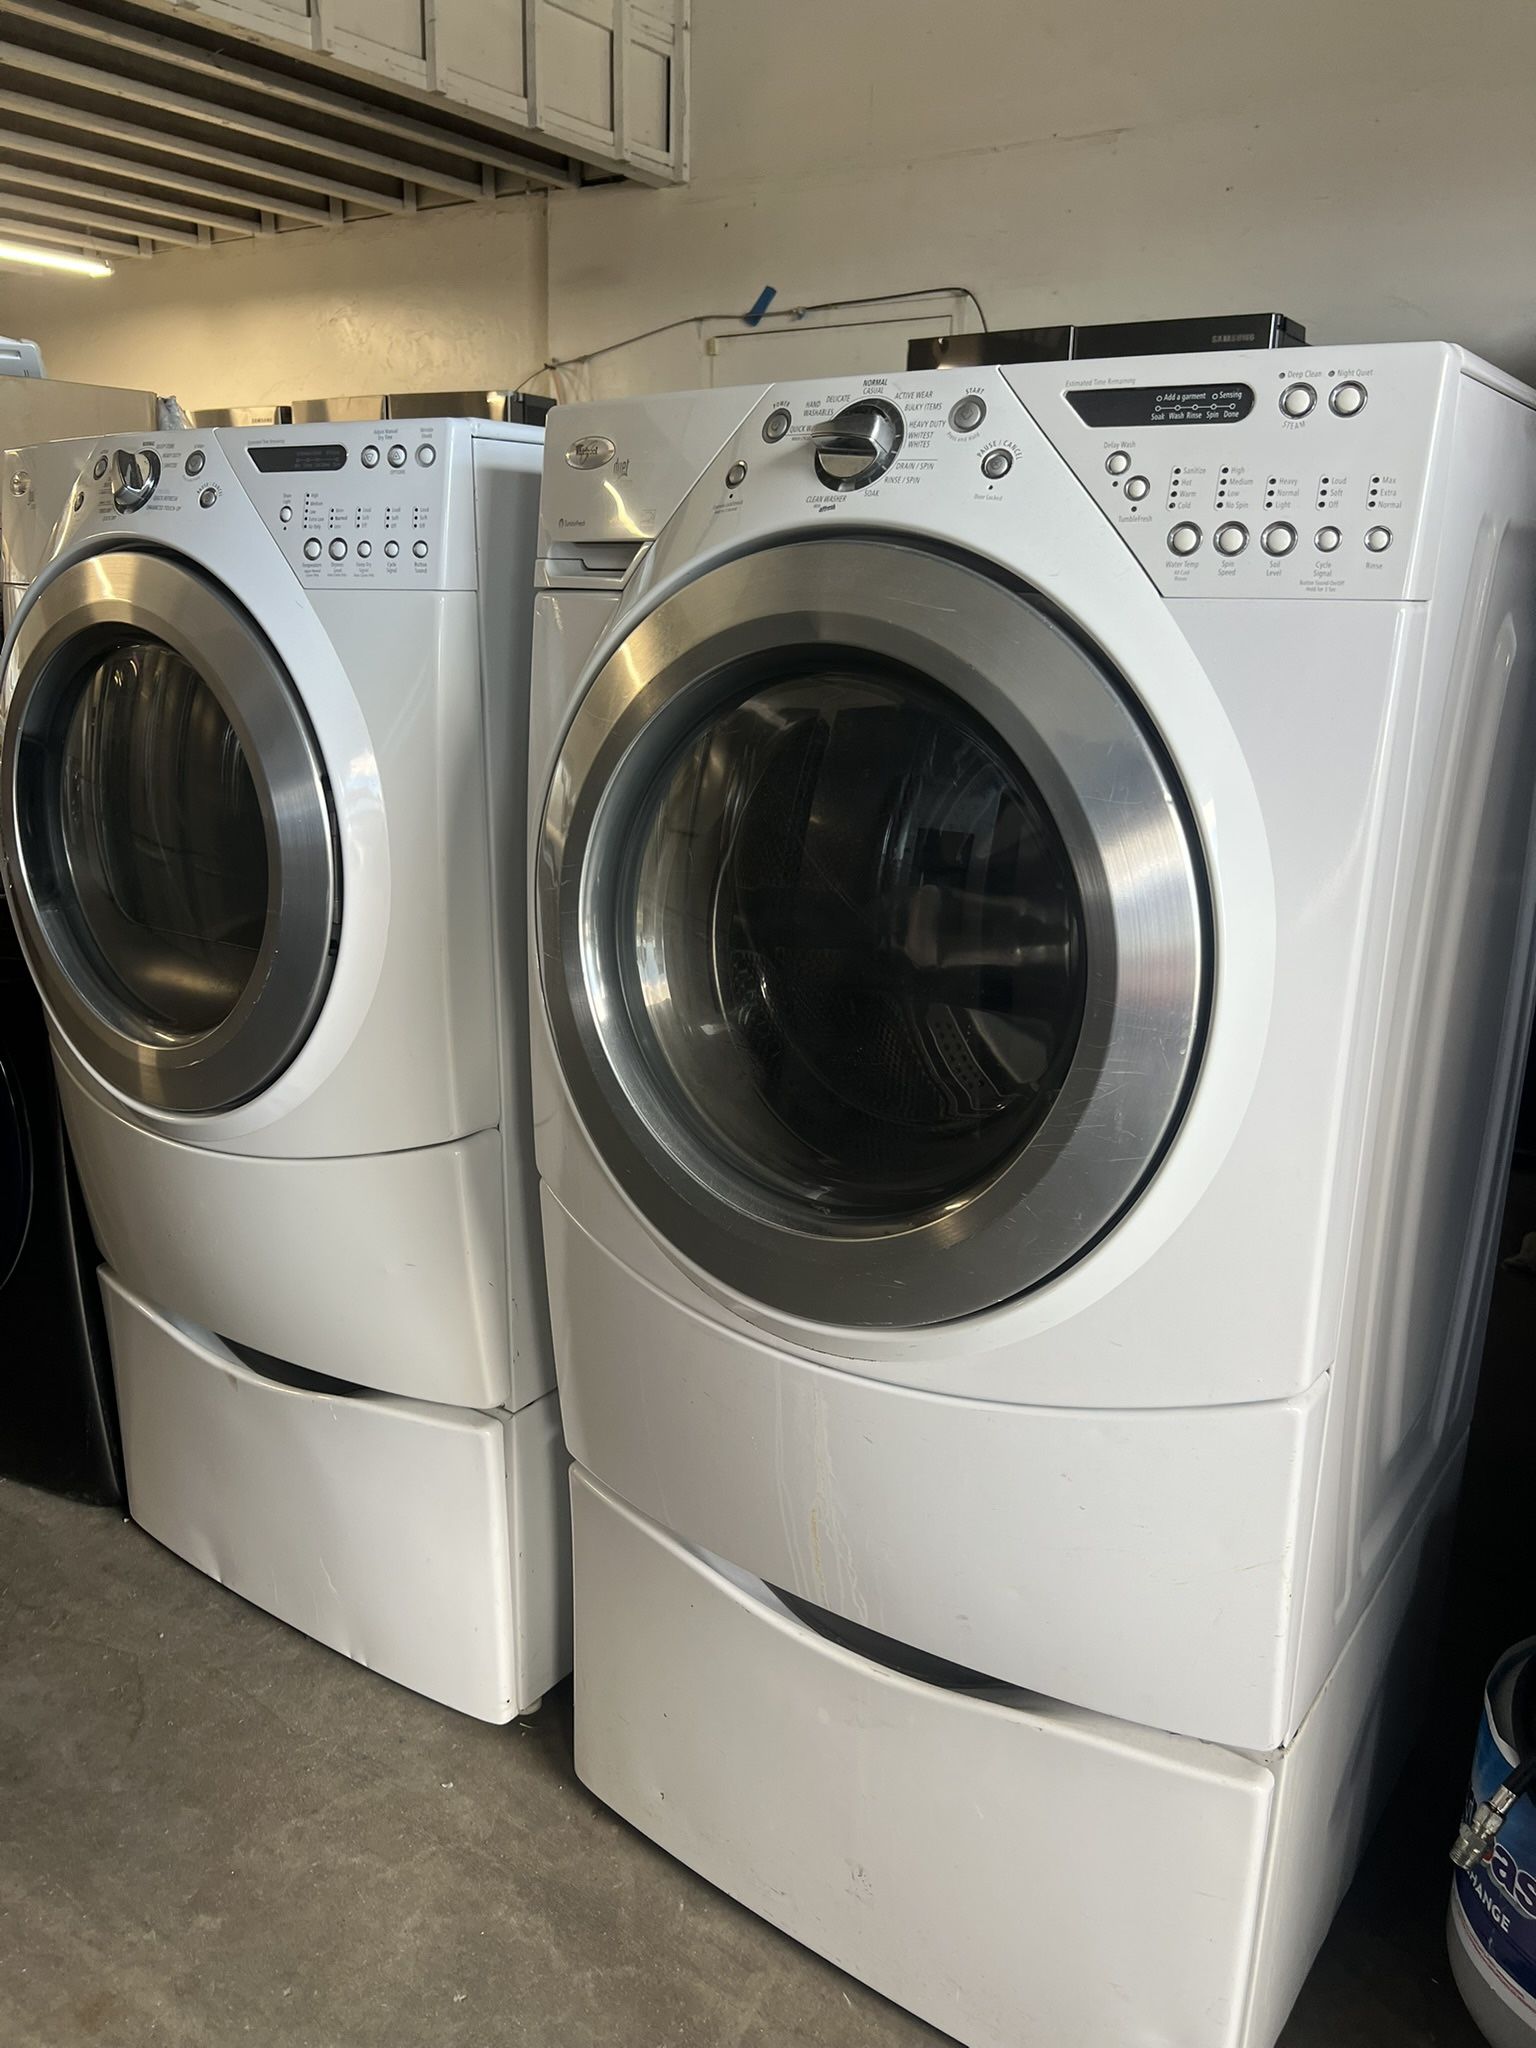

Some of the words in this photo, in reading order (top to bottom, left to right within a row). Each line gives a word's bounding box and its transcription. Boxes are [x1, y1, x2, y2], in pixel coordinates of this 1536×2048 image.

[1211, 334, 1255, 343] SAMSUNG
[1287, 370, 1303, 379] Deep
[1305, 369, 1322, 378] Clean
[1337, 369, 1354, 378] Night
[1356, 368, 1373, 377] Quiet
[862, 378, 888, 387] NORMAL
[1065, 379, 1092, 387] Estimated
[1107, 377, 1136, 385] Remaining
[862, 386, 884, 395] CASUAL
[895, 391, 914, 400] ACTIVE
[915, 390, 933, 399] WEAR
[965, 387, 985, 395] START
[826, 394, 851, 403] DELICATE
[1163, 393, 1176, 401] Add
[1181, 392, 1206, 402] garment
[1219, 391, 1242, 400] Sensing
[773, 400, 790, 409] POWER
[806, 400, 821, 408] HAND
[904, 403, 922, 412] BULKY
[923, 402, 942, 411] ITEMS
[803, 408, 833, 417] WASHABLES
[1168, 412, 1184, 420] Wash
[1186, 411, 1202, 419] Rinse
[1206, 410, 1219, 420] Spin
[1223, 410, 1239, 418] Done
[908, 420, 928, 429] HEAVY
[929, 419, 946, 429] DUTY
[1282, 420, 1305, 430] STEAM
[789, 424, 807, 434] QUICK
[908, 431, 933, 440] WHITEST
[908, 440, 930, 449] WHITES
[1103, 441, 1120, 450] Delay
[1120, 440, 1136, 449] Wash
[976, 440, 997, 458] PAUSE
[1002, 439, 1023, 461] CANCEL
[895, 462, 915, 470] DRAIN
[919, 462, 934, 470] SPIN
[1183, 466, 1206, 475] Sanitize
[1231, 466, 1245, 476] High
[884, 475, 902, 484] RINSE
[906, 475, 920, 485] SPIN
[1229, 478, 1253, 486] Medium
[1279, 477, 1298, 486] Heavy
[1331, 477, 1347, 485] Loud
[864, 489, 880, 497] SOAK
[1179, 490, 1197, 498] Warm
[1227, 489, 1240, 498] Low
[1277, 489, 1299, 497] Normal
[1330, 488, 1344, 497] Soft
[1380, 488, 1397, 497] Extra
[805, 496, 823, 504] CLEAN
[824, 495, 848, 503] WASHER
[1177, 501, 1191, 509] Cold
[1226, 501, 1235, 509] No
[1236, 501, 1249, 510] Spin
[1275, 501, 1291, 510] Light
[1378, 501, 1402, 509] Normal
[1165, 560, 1183, 568] Water
[1184, 560, 1199, 569] Temp
[1221, 560, 1234, 569] Spin
[1269, 560, 1281, 568] Soil
[1315, 561, 1331, 570] Cycle
[1365, 561, 1383, 570] Rinse
[1217, 568, 1236, 577] Speed
[1266, 569, 1282, 577] Level
[1313, 569, 1332, 579] Signal
